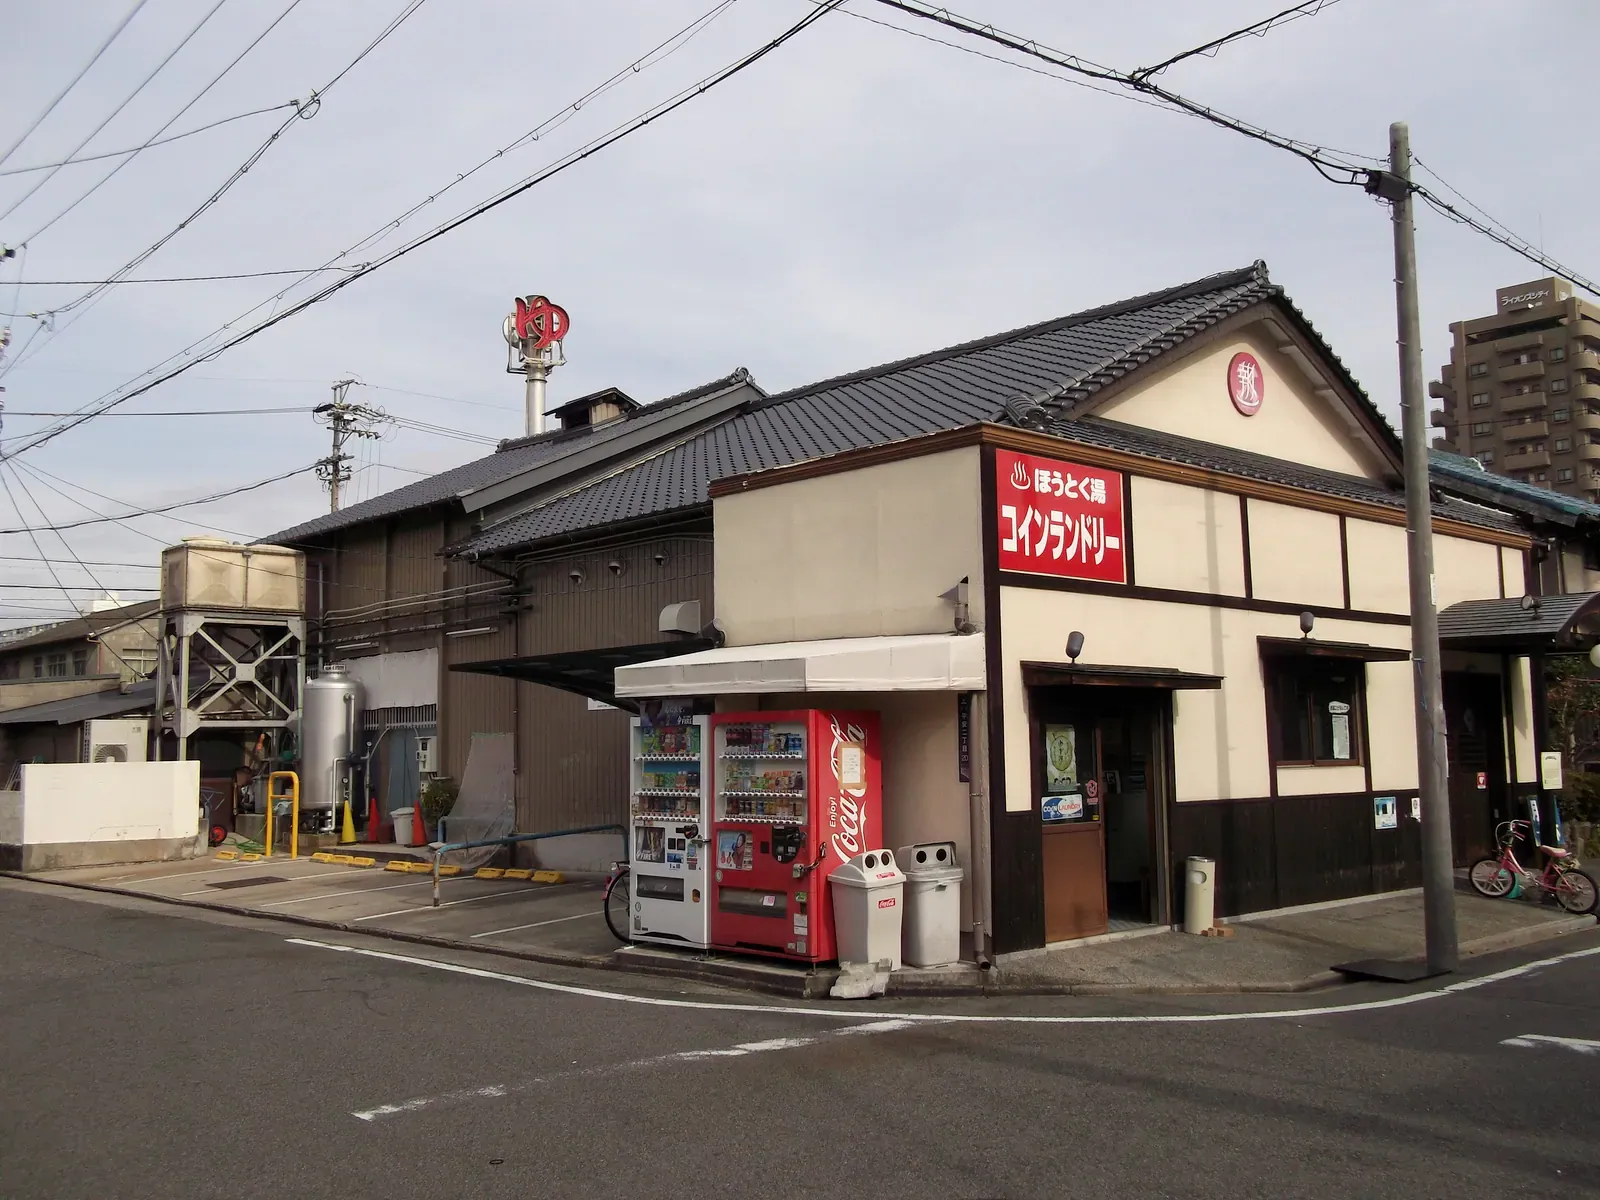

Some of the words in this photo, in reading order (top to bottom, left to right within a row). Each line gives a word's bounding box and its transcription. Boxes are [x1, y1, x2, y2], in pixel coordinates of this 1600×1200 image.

[515, 296, 570, 349] ゆ
[1034, 468, 1106, 505] ほうとく湯
[1001, 504, 1120, 565] コインランドリー
[829, 796, 838, 828] Enjoy!
